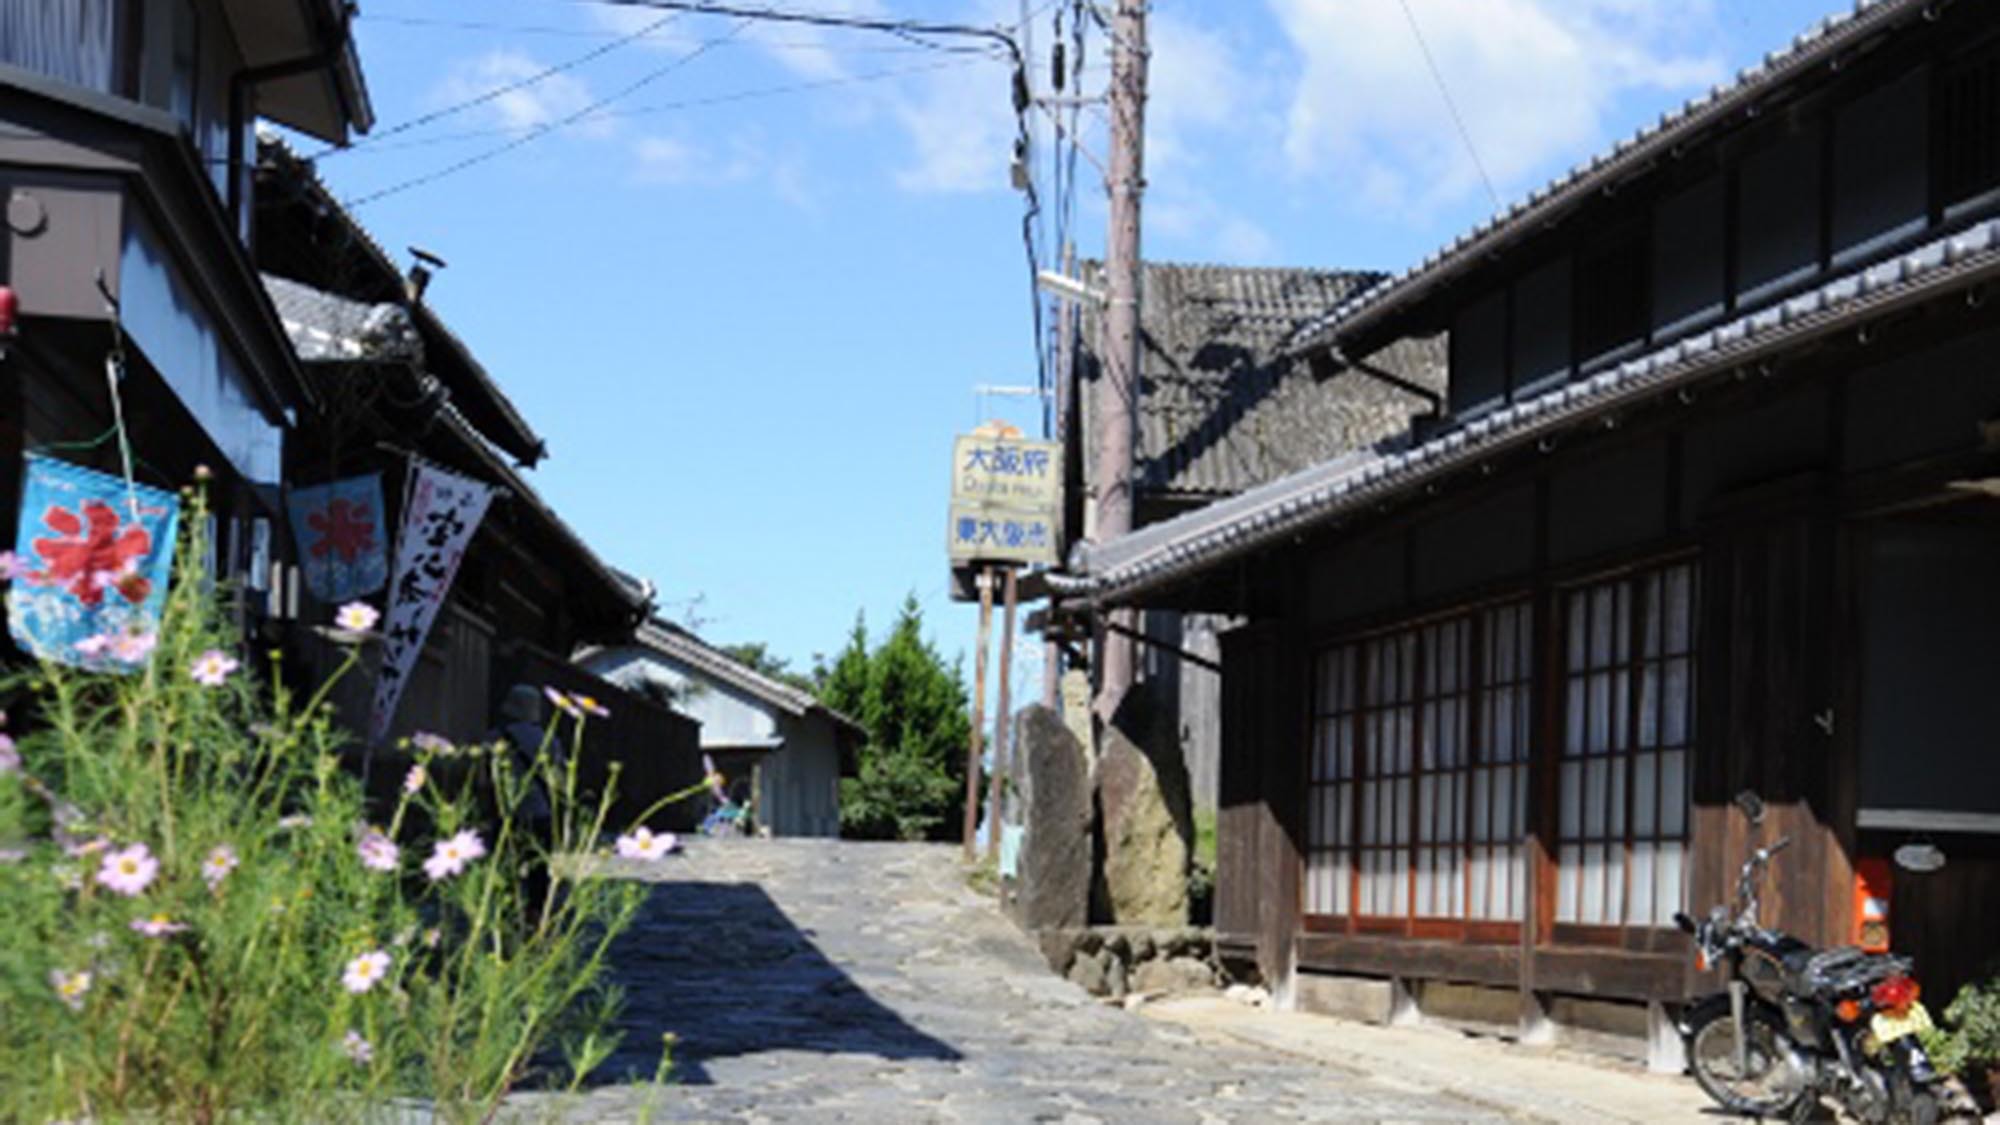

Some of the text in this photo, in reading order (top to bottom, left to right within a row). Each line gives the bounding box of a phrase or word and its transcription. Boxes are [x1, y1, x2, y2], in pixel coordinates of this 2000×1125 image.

[963, 446, 1049, 477] 大阪府
[956, 516, 1047, 548] 東大阪市
